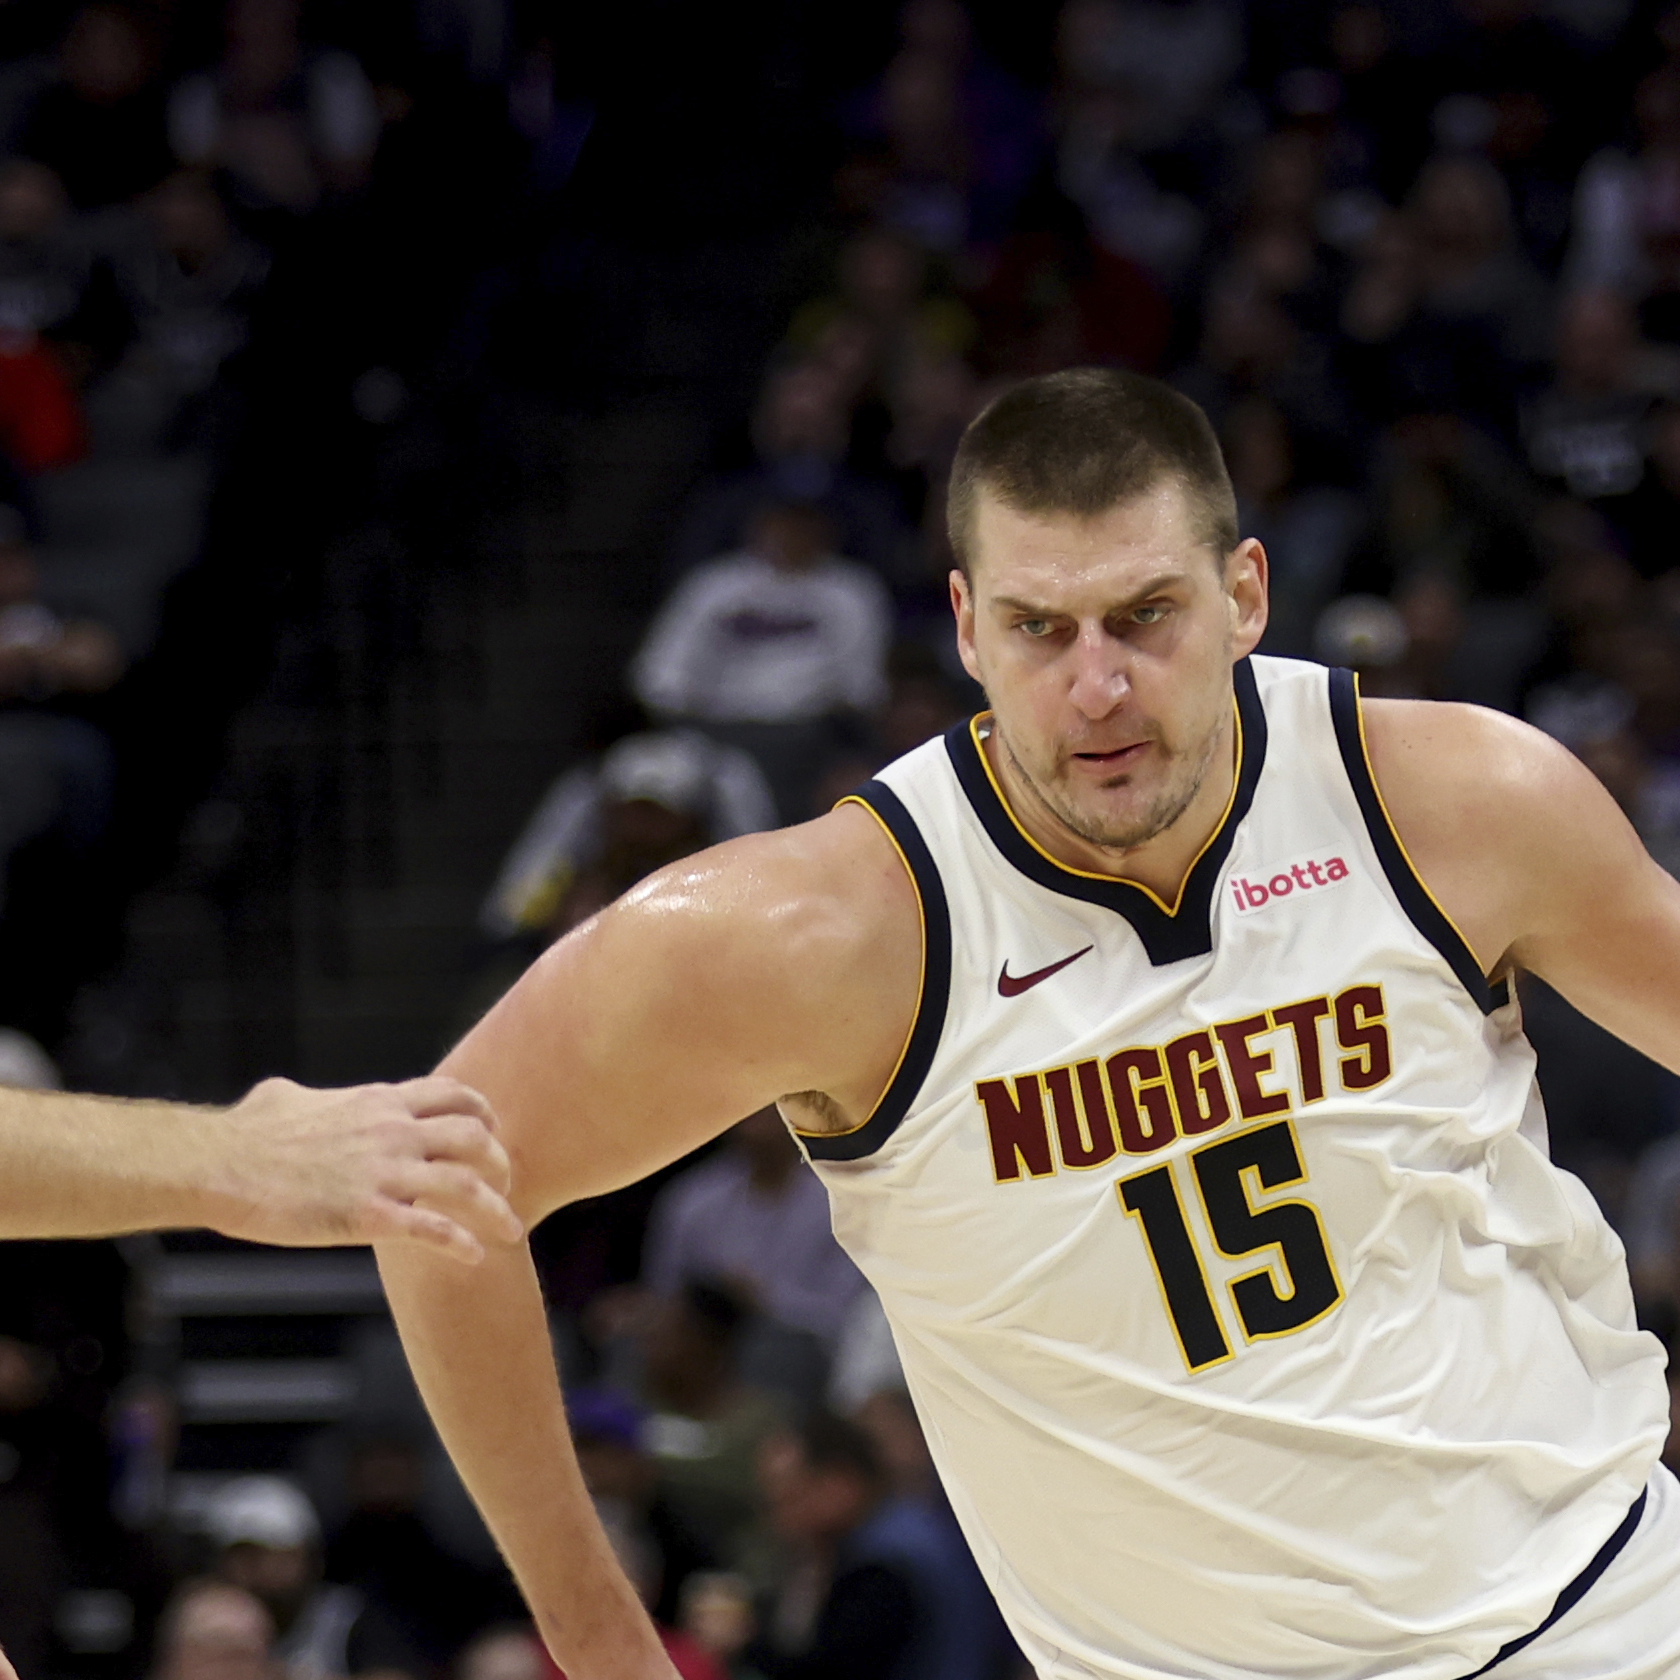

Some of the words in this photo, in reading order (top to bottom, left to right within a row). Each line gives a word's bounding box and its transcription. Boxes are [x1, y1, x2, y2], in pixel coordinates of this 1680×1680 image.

[1230, 856, 1350, 911] ibotta
[974, 982, 1392, 1184] NUGGETS
[1114, 1119, 1346, 1376] 15
